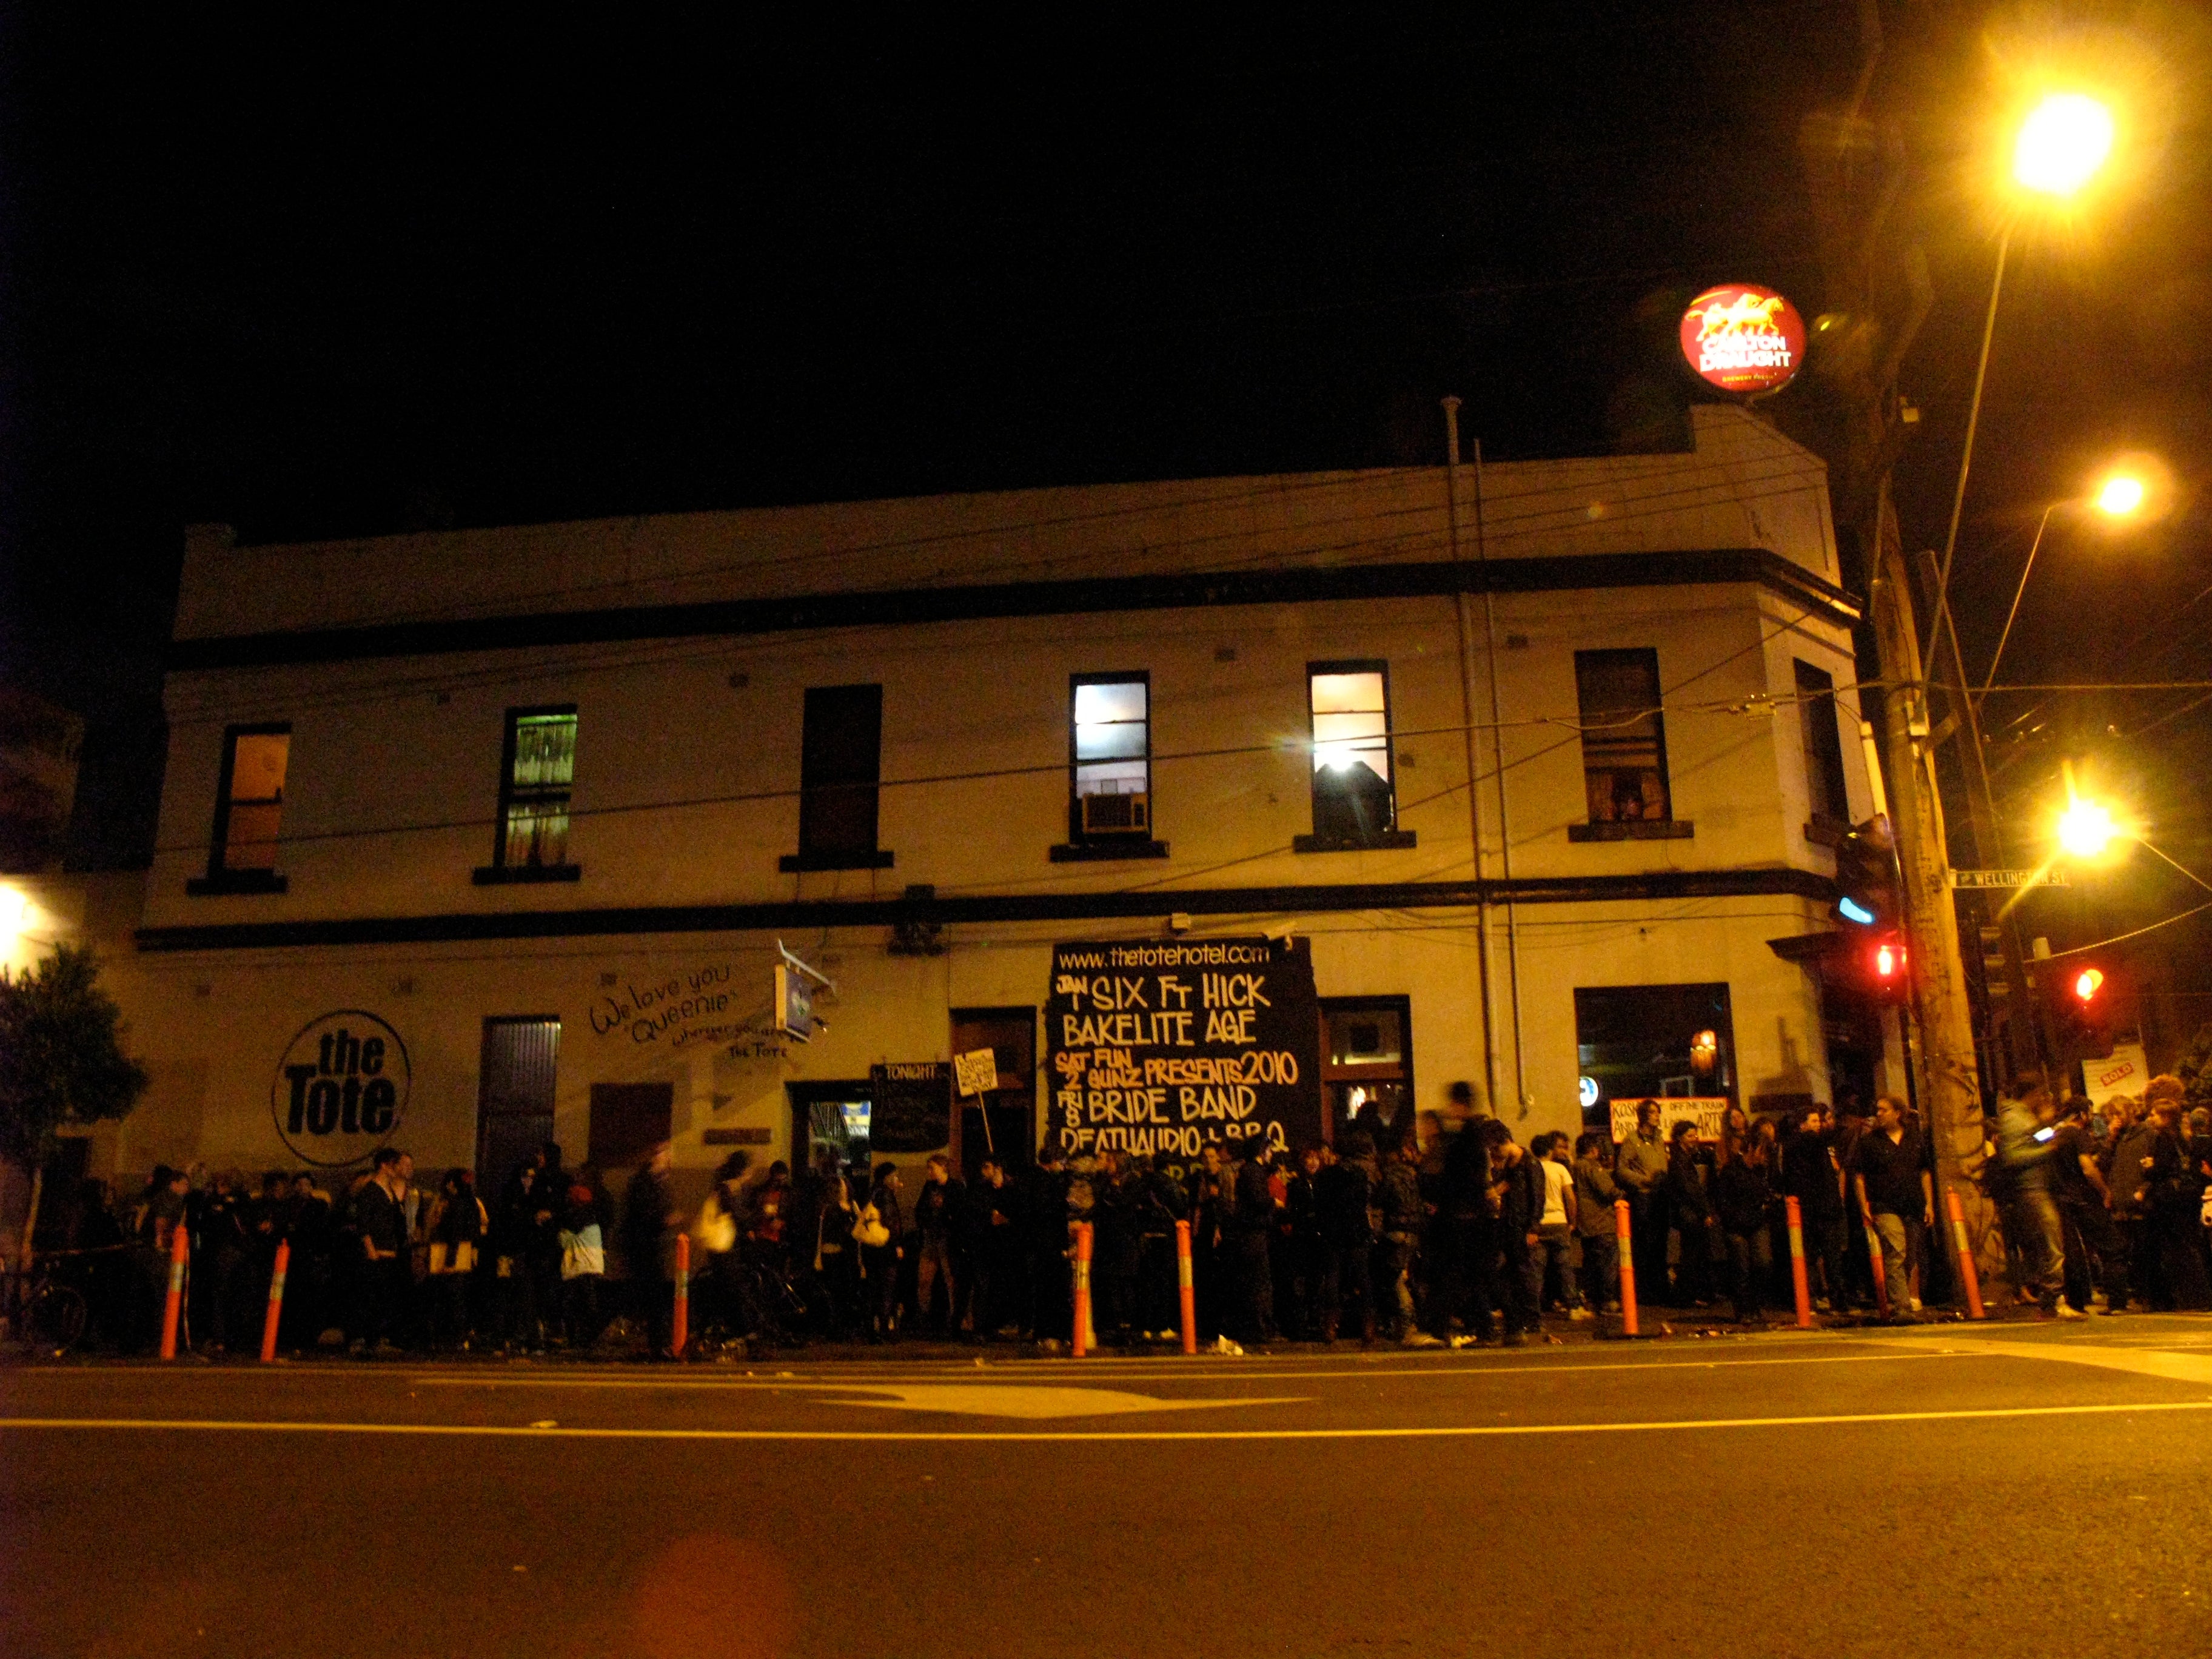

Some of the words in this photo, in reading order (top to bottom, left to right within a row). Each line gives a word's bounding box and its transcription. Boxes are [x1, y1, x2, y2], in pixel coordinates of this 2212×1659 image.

[1702, 335, 1786, 354] CARLTON
[1700, 350, 1791, 372] DRAUGHT
[1975, 871, 2049, 885] WELLINGN
[1059, 943, 1270, 969] www.thetotehotel.com
[590, 997, 630, 1034] We
[628, 979, 679, 1009] love
[688, 965, 729, 993] you
[1092, 976, 1148, 1011] SIX
[1202, 973, 1271, 1009] HICK
[1063, 1011, 1195, 1047] BAKELITE
[1205, 1009, 1256, 1045] AGE
[319, 1029, 385, 1076] the
[1055, 1051, 1091, 1073] SAT
[1094, 1047, 1133, 1069] FUN
[885, 1064, 937, 1081] TONIGHT
[1144, 1057, 1244, 1086] PRESENTS
[1241, 1050, 1299, 1085] 2010
[2102, 1064, 2132, 1085] SOLD
[1064, 1071, 1082, 1091] 2
[285, 1065, 395, 1135] Tote
[1088, 1088, 1170, 1124] BRIDE
[1179, 1084, 1258, 1122] BAND
